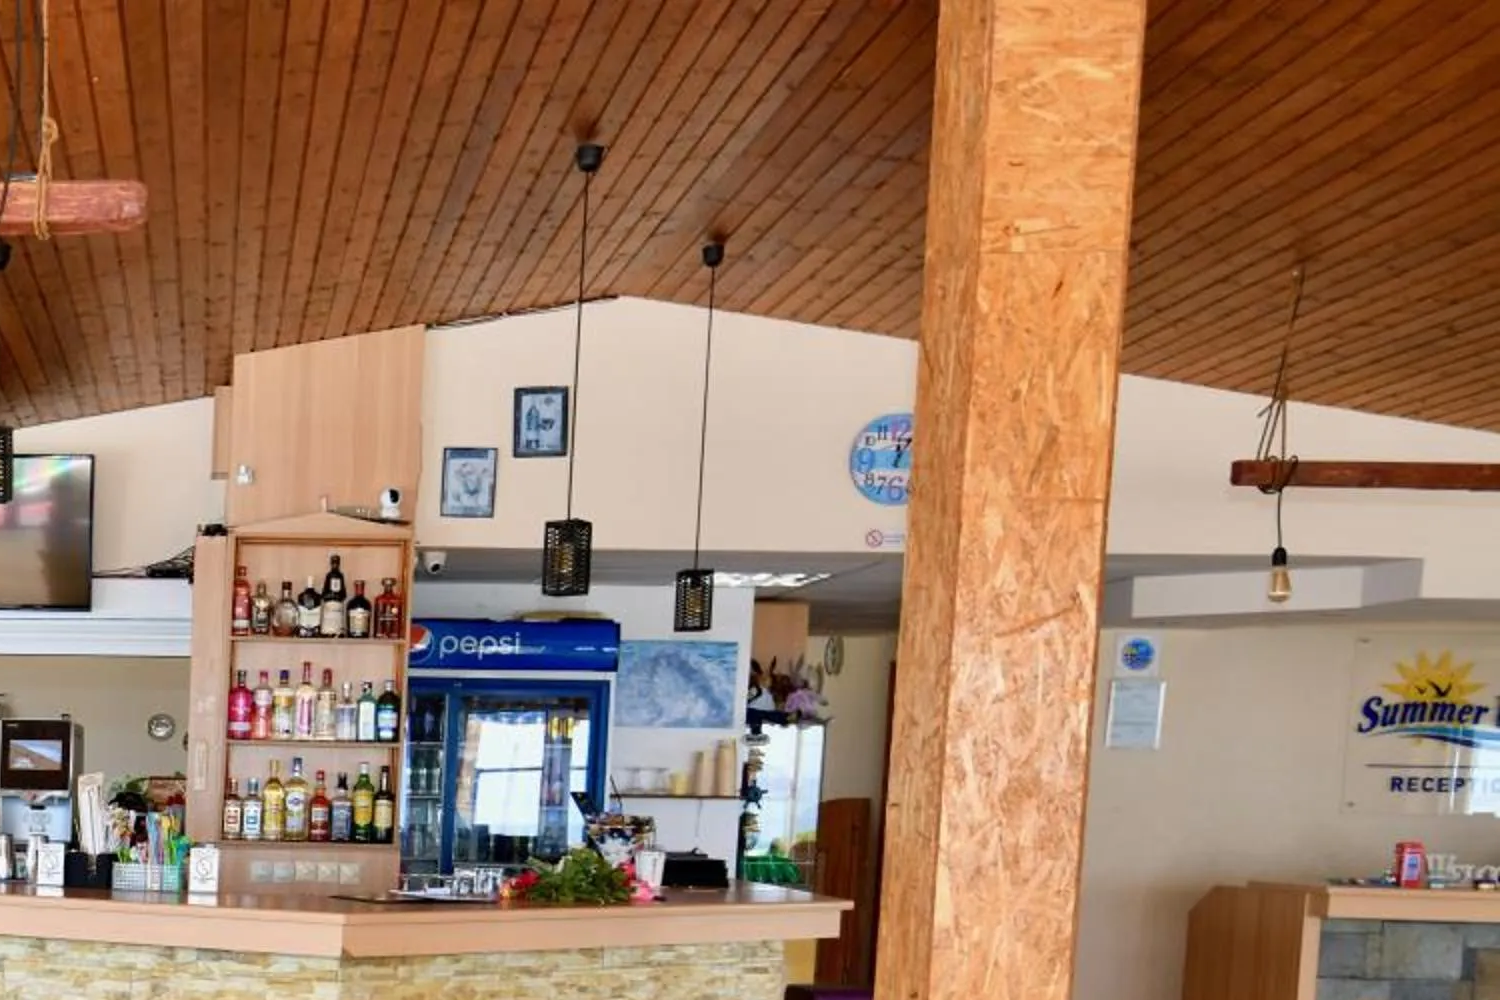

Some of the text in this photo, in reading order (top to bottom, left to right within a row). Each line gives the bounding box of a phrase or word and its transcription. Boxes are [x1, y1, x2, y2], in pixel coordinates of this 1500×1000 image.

[857, 447, 874, 474] 9
[876, 475, 887, 495] 7
[888, 475, 904, 501] 6
[438, 631, 521, 661] pepsi
[1358, 695, 1490, 734] Summer
